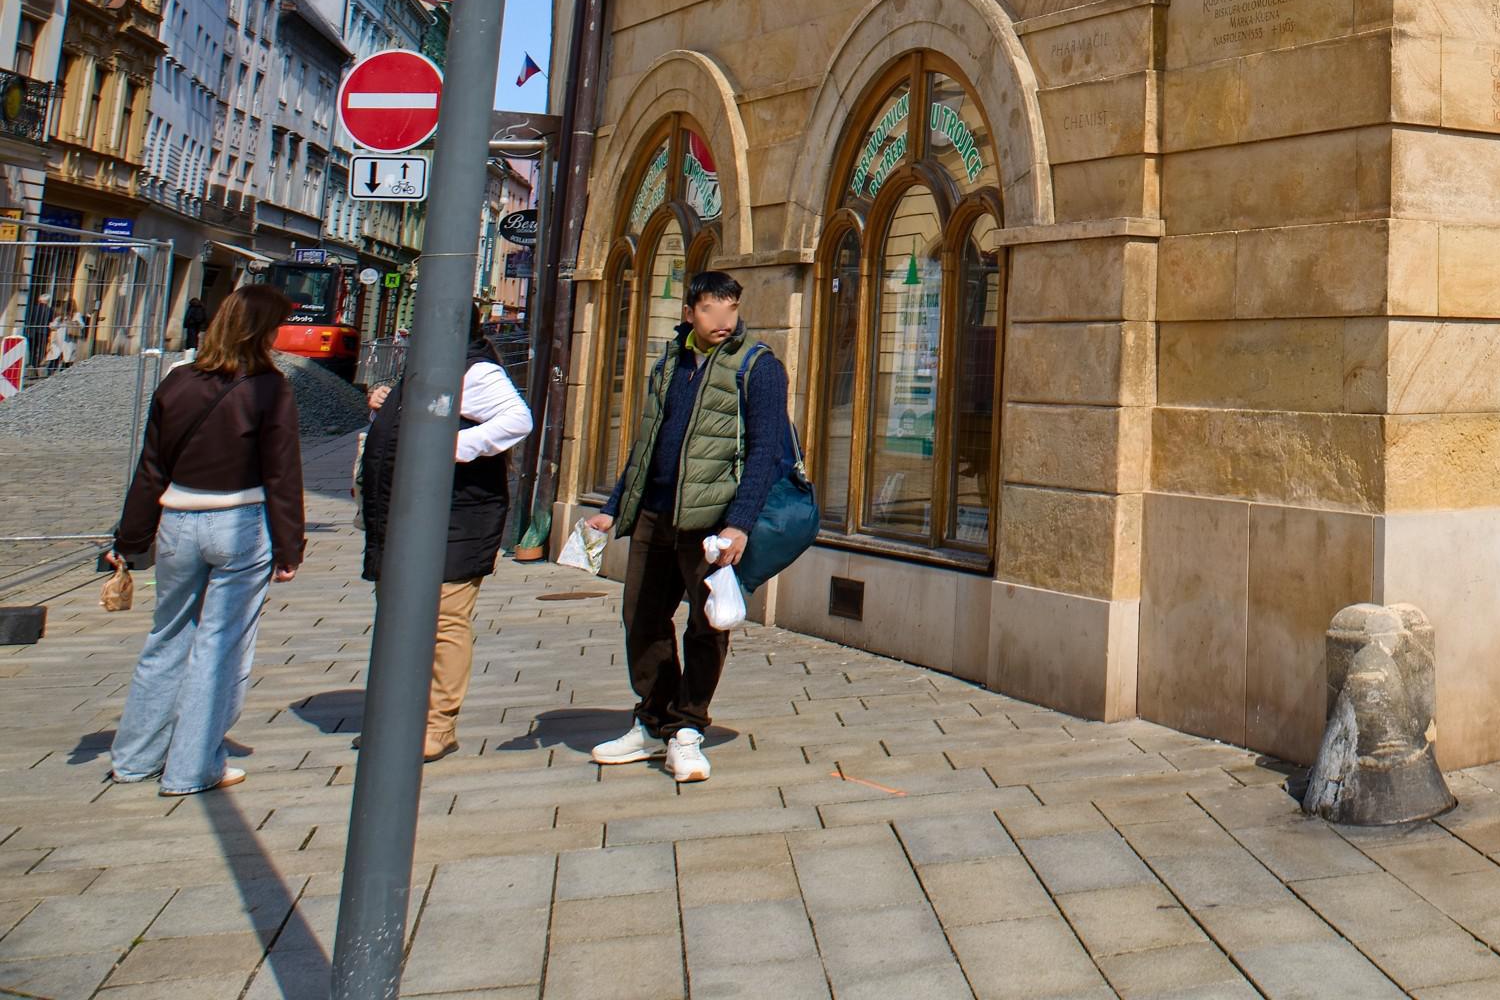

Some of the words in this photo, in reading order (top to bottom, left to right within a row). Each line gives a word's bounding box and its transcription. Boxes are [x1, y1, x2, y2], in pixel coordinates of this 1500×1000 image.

[852, 92, 910, 197] ZDRAVOTNICK
[930, 102, 941, 130] U
[941, 105, 982, 184] TROJICE
[1064, 110, 1109, 129] CHEMIST
